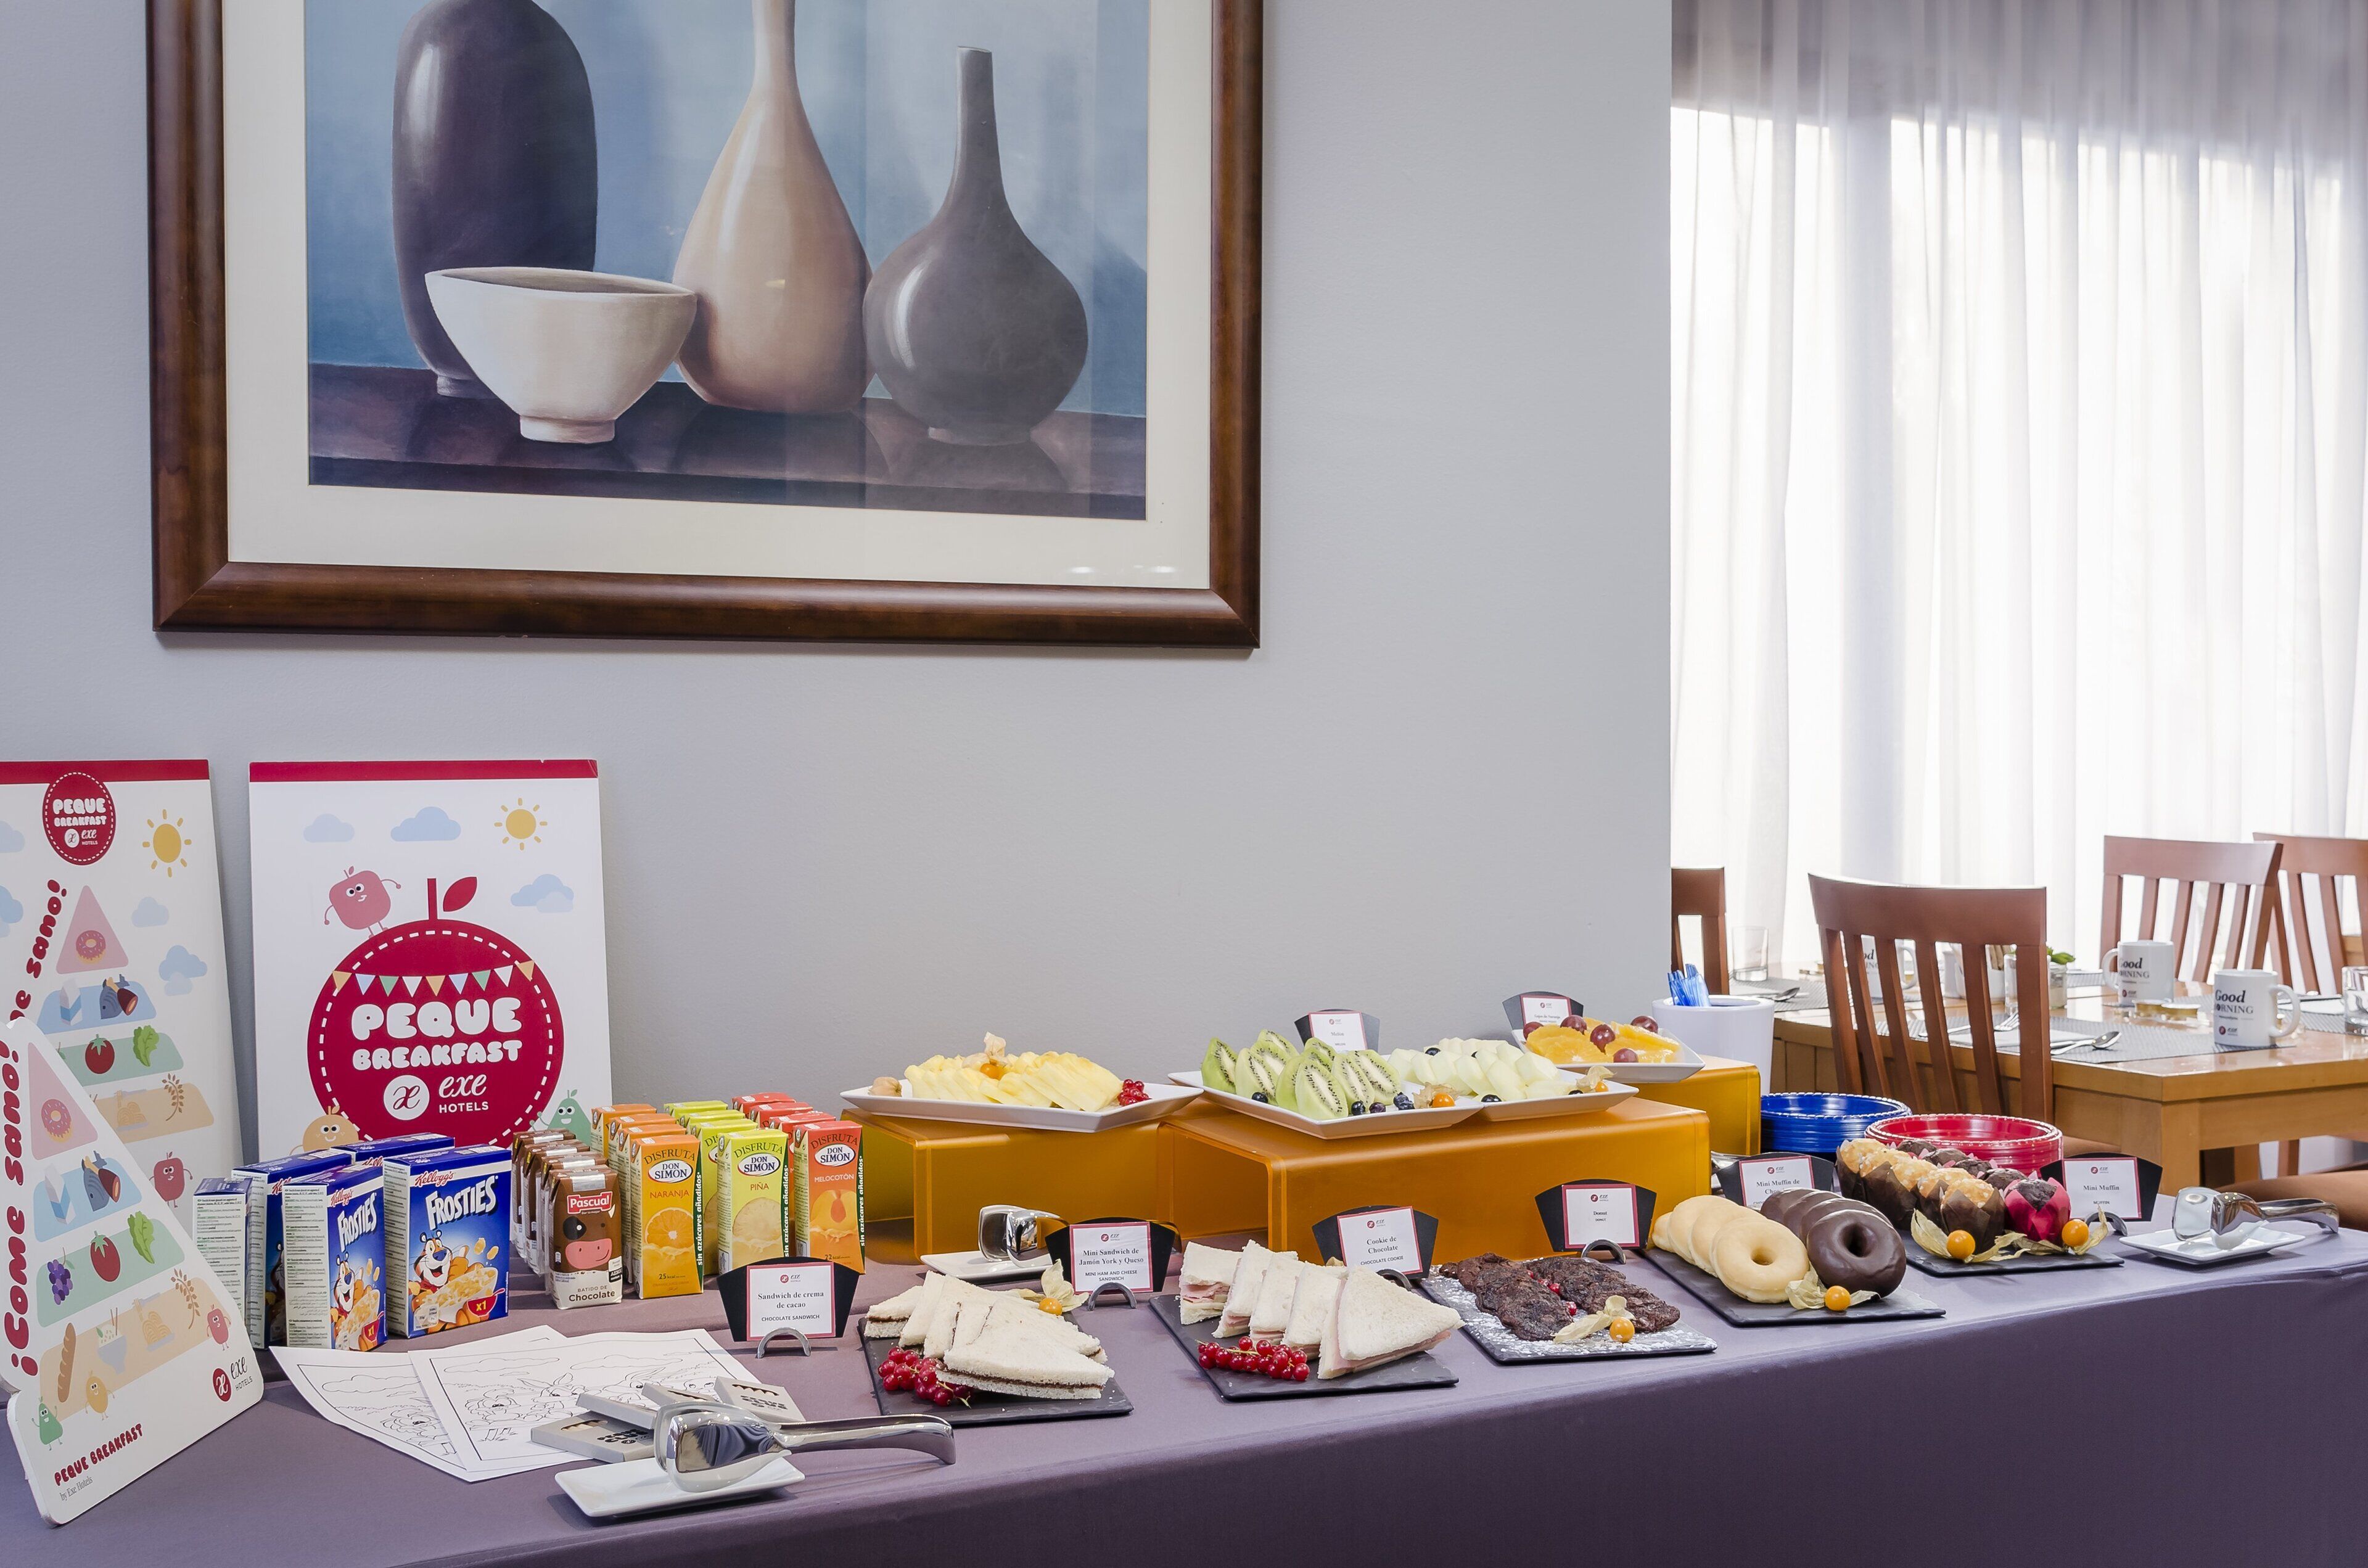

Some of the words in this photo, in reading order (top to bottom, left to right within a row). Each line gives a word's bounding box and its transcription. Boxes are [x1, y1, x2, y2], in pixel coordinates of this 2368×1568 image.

[52, 798, 107, 815] PEQUE
[54, 816, 107, 827] BREAKFAST
[81, 829, 97, 839] exe
[26, 879, 67, 979] sano!
[2119, 957, 2143, 969] ood
[2215, 989, 2246, 1003] Good
[2214, 1003, 2254, 1014] ORNING
[351, 997, 522, 1041] PEQUE
[352, 1040, 523, 1070] BREAKFAST
[438, 1073, 487, 1098] exe
[0, 1040, 23, 1186] sano!
[438, 1101, 490, 1114] HOTELS
[810, 1134, 858, 1150] DISFRUTA
[644, 1147, 695, 1166] DISFRUTA
[734, 1142, 783, 1158] DISFRUTA
[827, 1146, 843, 1154] DON
[820, 1152, 850, 1164] SIMON
[662, 1162, 679, 1171] DON
[744, 1162, 775, 1173] SIMON
[414, 1170, 454, 1187] Kellogg's
[654, 1168, 688, 1180] SIMON
[814, 1172, 854, 1183] MELOCOTÓN
[750, 1182, 769, 1191] PIÑA
[331, 1189, 353, 1207] Kellogg's
[649, 1189, 689, 1199] NARANJA
[426, 1178, 496, 1230] FROSTIES
[570, 1195, 609, 1209] Pascual
[337, 1192, 377, 1253] FROSTIES
[1367, 1237, 1388, 1246] Cookie
[1368, 1245, 1399, 1254] Chocolate
[1079, 1258, 1100, 1266] Jamón
[1360, 1257, 1387, 1265] CHOCOLATE
[4, 1206, 38, 1376] ¡Come
[569, 1291, 615, 1302] Chocolate
[758, 1292, 791, 1300] Sandwich
[475, 1300, 487, 1312] x1
[368, 1326, 375, 1337] x1
[230, 1357, 248, 1380] exe
[236, 1376, 253, 1391] HOTELS
[54, 1456, 89, 1487] PEQUE
[89, 1423, 144, 1465] BREAKFAST
[60, 1492, 67, 1501] by
[68, 1486, 78, 1497] Exe
[78, 1476, 93, 1494] Hotels
